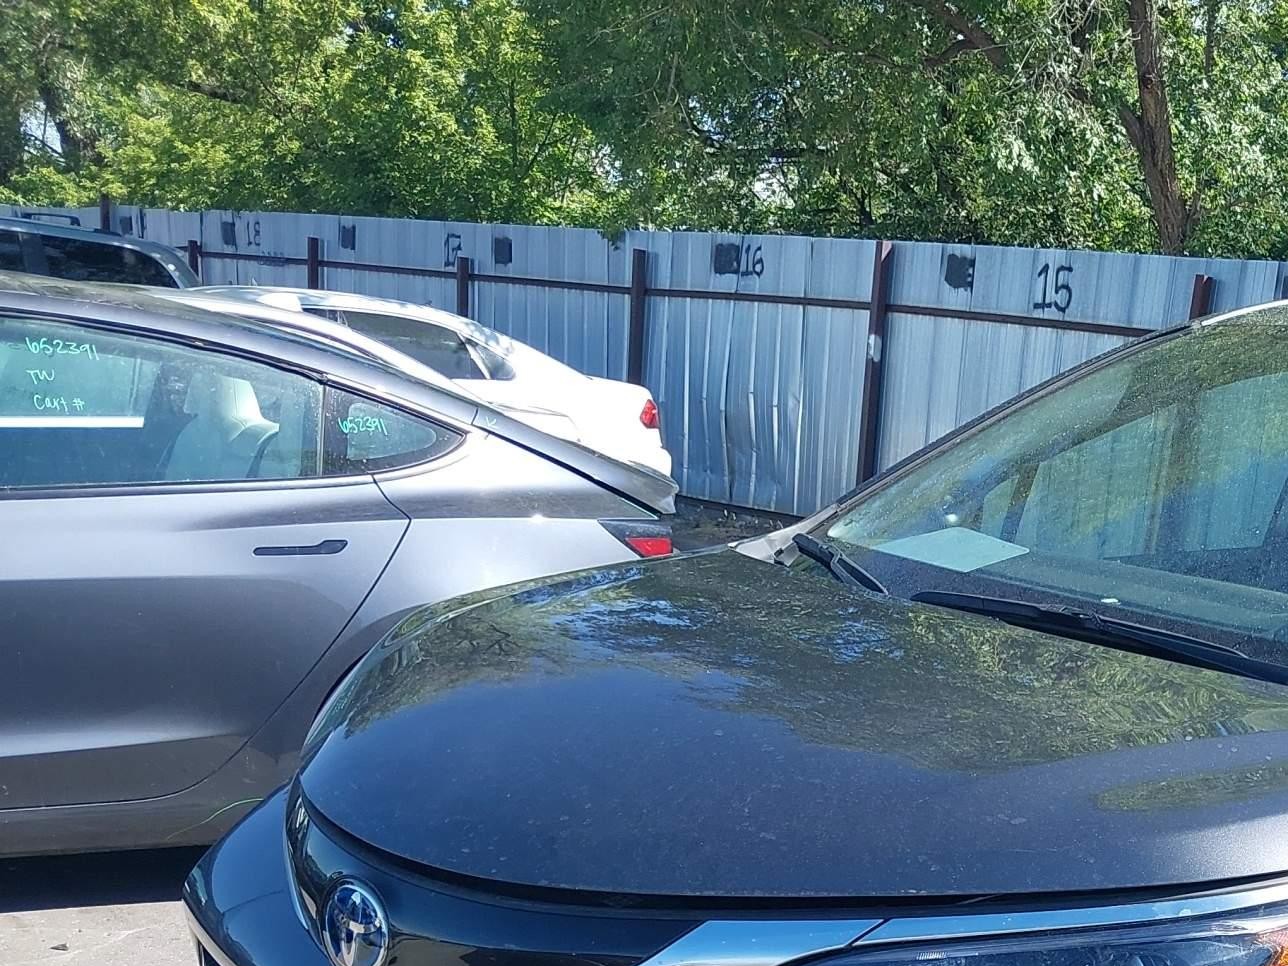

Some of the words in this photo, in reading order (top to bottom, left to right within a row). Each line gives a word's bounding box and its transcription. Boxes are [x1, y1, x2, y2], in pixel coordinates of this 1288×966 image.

[741, 243, 765, 279] 16
[1033, 262, 1074, 312] 15
[25, 336, 100, 361] 652391
[25, 368, 55, 385] TW
